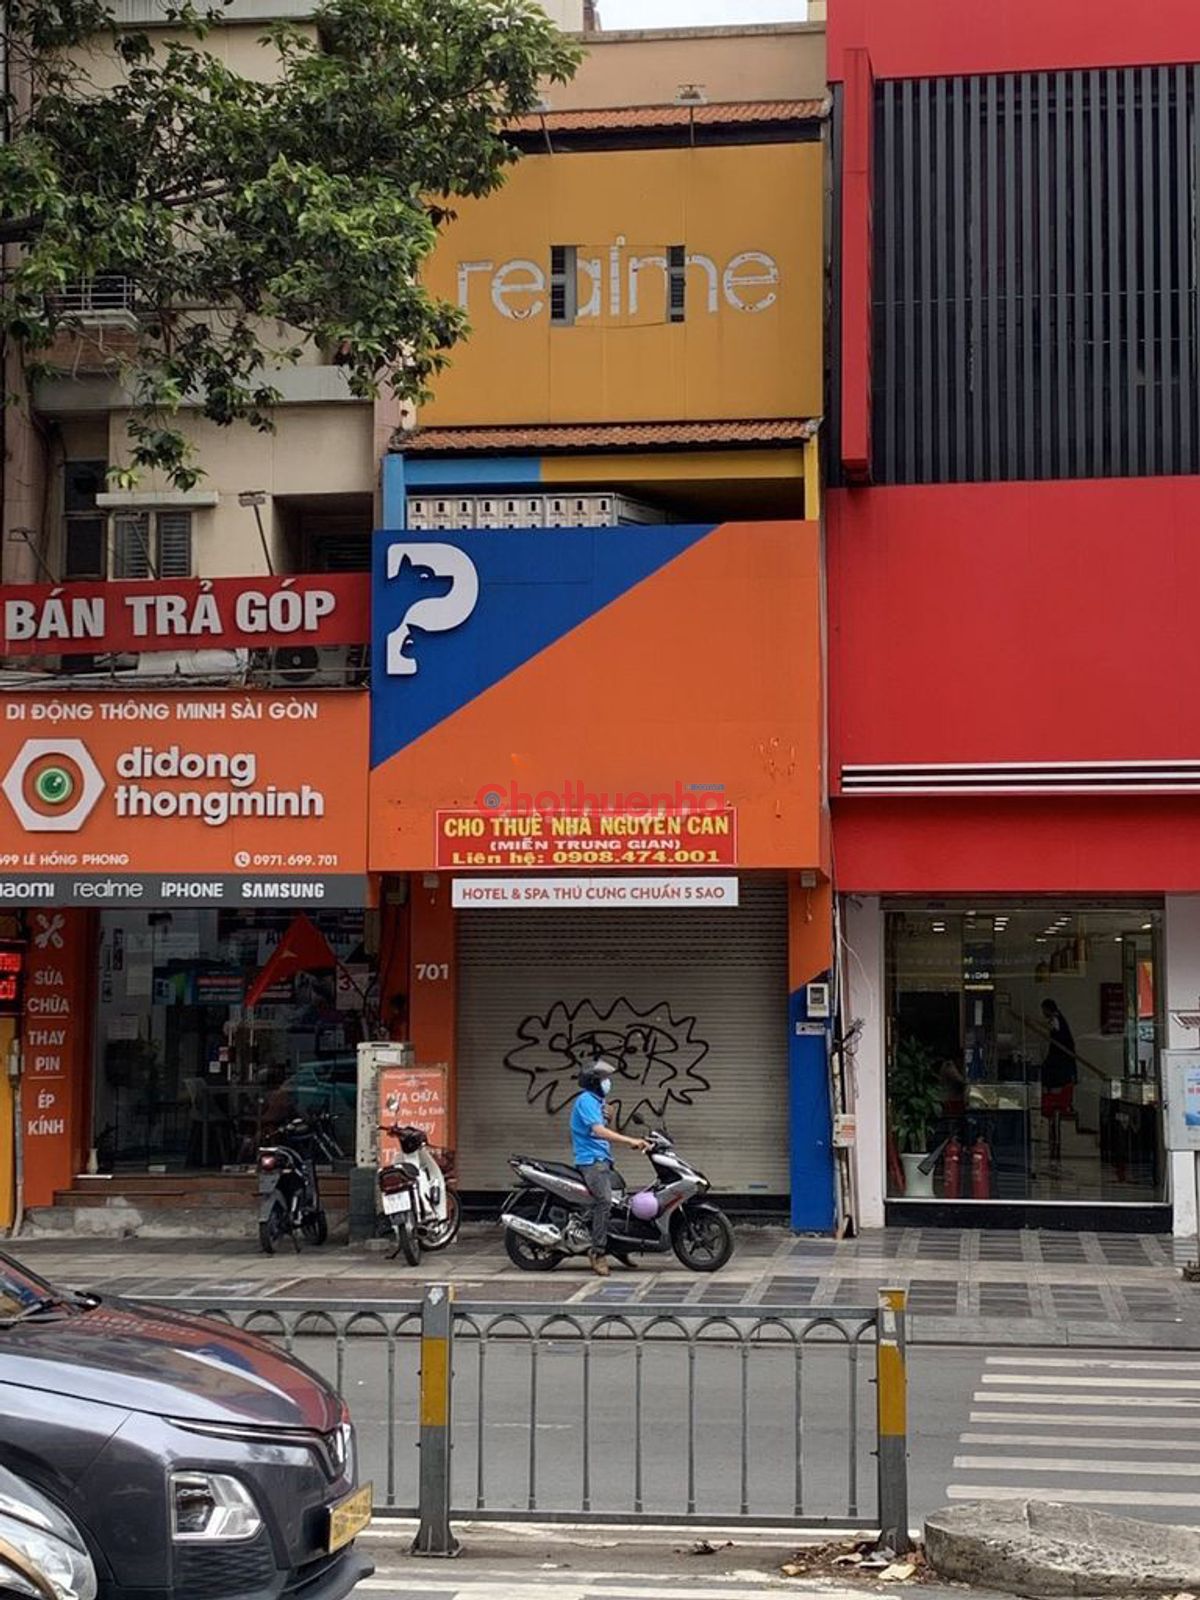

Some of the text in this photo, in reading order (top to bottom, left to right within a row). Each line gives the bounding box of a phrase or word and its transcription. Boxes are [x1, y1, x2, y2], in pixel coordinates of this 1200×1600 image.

[4, 578, 336, 641] BÁN TRẢ GÓP
[6, 697, 319, 725] DI ĐỘNG THÔNG MINH SÀI GÒN
[116, 746, 256, 787] didong
[115, 785, 325, 826] thongminh
[444, 817, 485, 837] CHO
[490, 811, 543, 837] THUÊ
[554, 840, 622, 850] TRUNG
[627, 839, 681, 851] GIAN)
[82, 854, 130, 865] PHONG
[253, 854, 338, 867] 0971.699.701
[452, 850, 720, 866] Liên hệ: 0908.474.001
[73, 879, 144, 898] realme
[242, 883, 325, 898] SAMSUNG
[462, 887, 508, 900] HOTEL
[511, 888, 521, 900] &
[524, 888, 549, 900] SPA
[684, 888, 693, 899] 5
[695, 887, 725, 899] SAO
[414, 963, 450, 980] 701
[28, 1031, 66, 1045] THAY
[35, 1057, 60, 1072] PIN
[37, 1088, 55, 1109] ÉP
[27, 1115, 65, 1136] KÍNH
